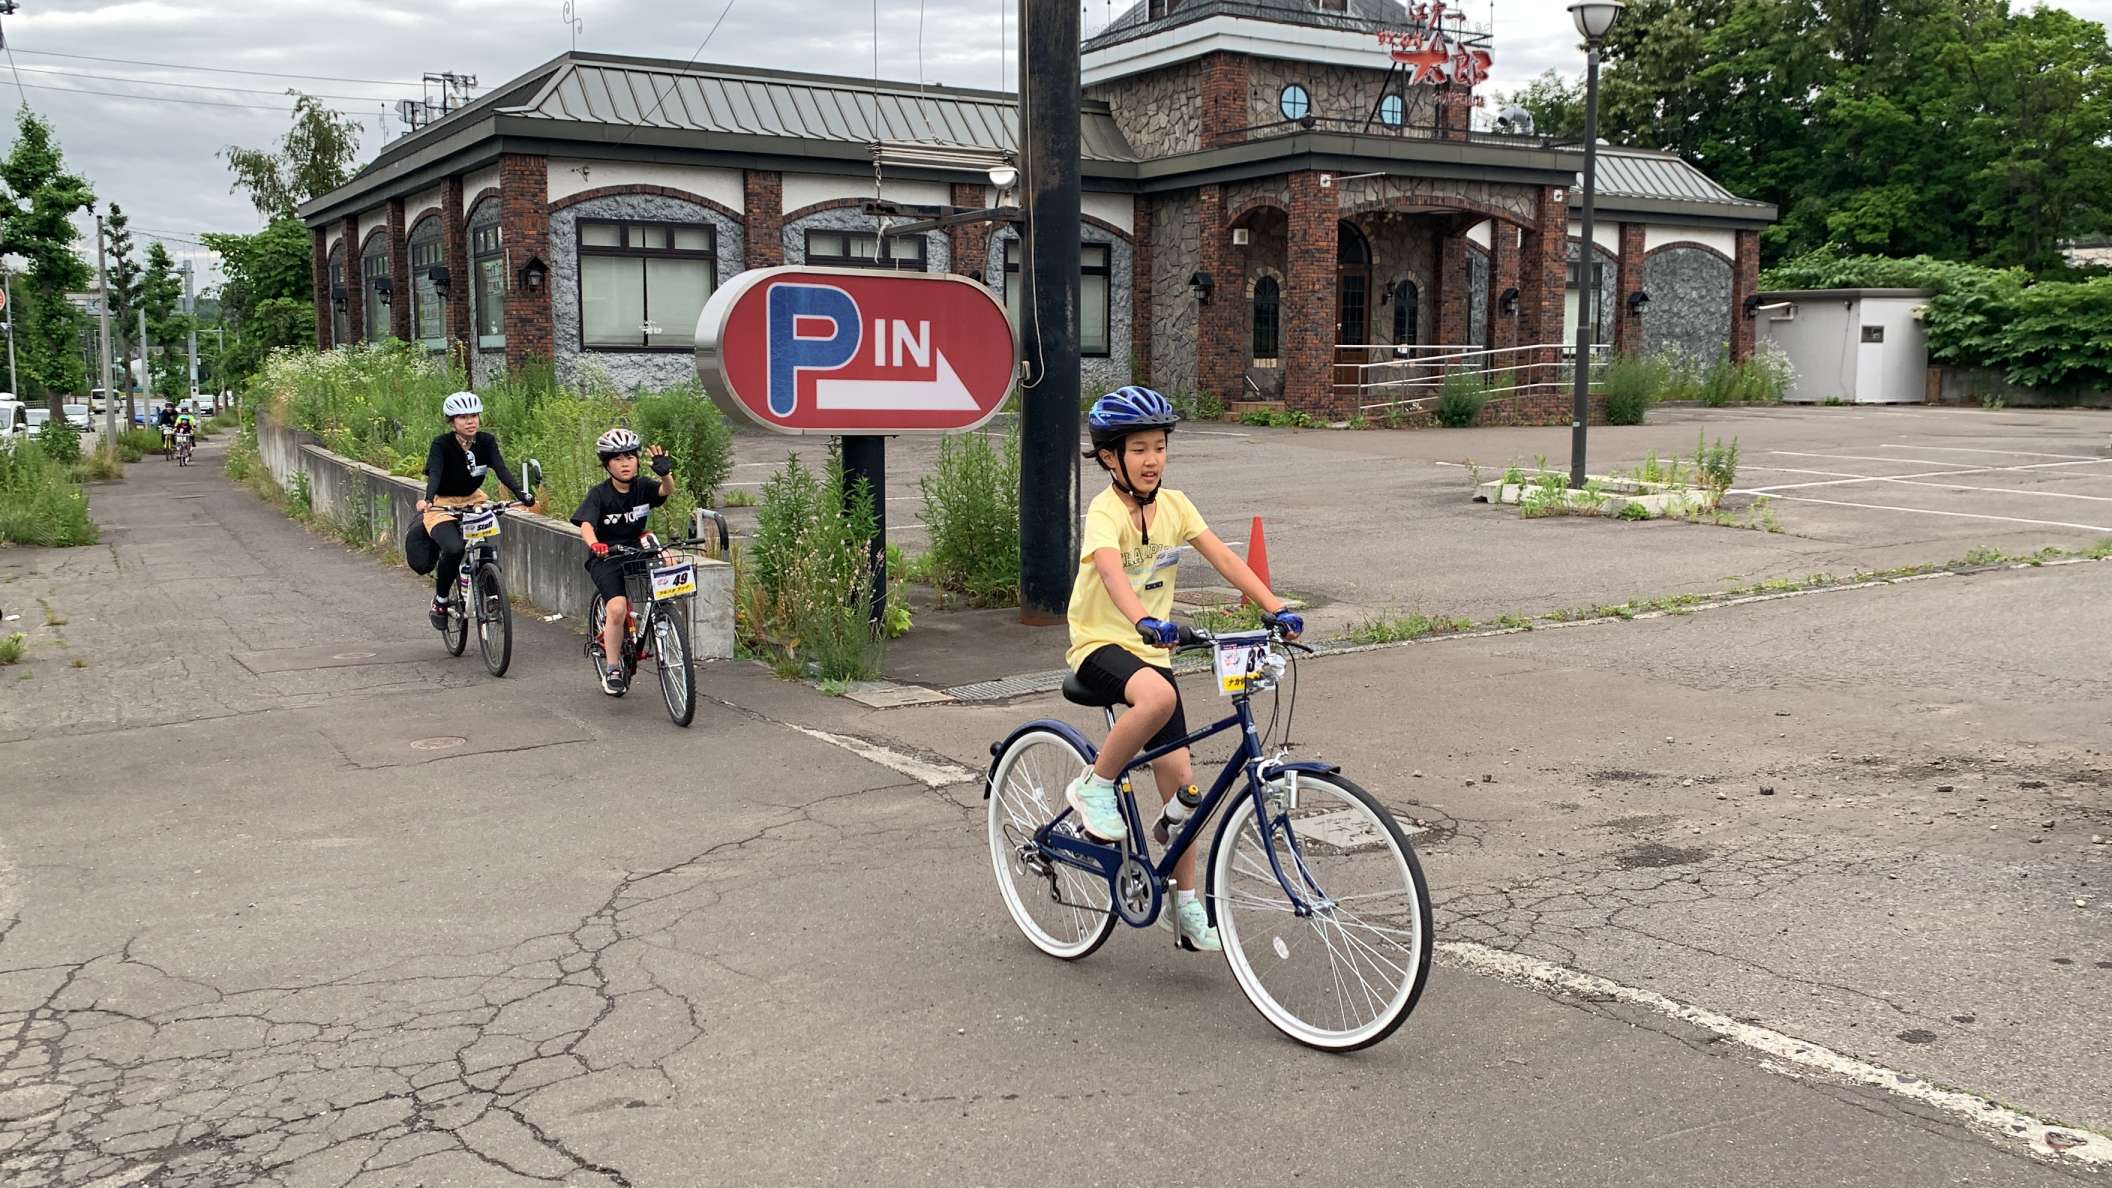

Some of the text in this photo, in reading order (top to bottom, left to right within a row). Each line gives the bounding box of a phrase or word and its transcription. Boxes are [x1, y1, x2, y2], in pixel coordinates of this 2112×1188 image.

[766, 282, 930, 418] P IN
[672, 572, 689, 587] 49
